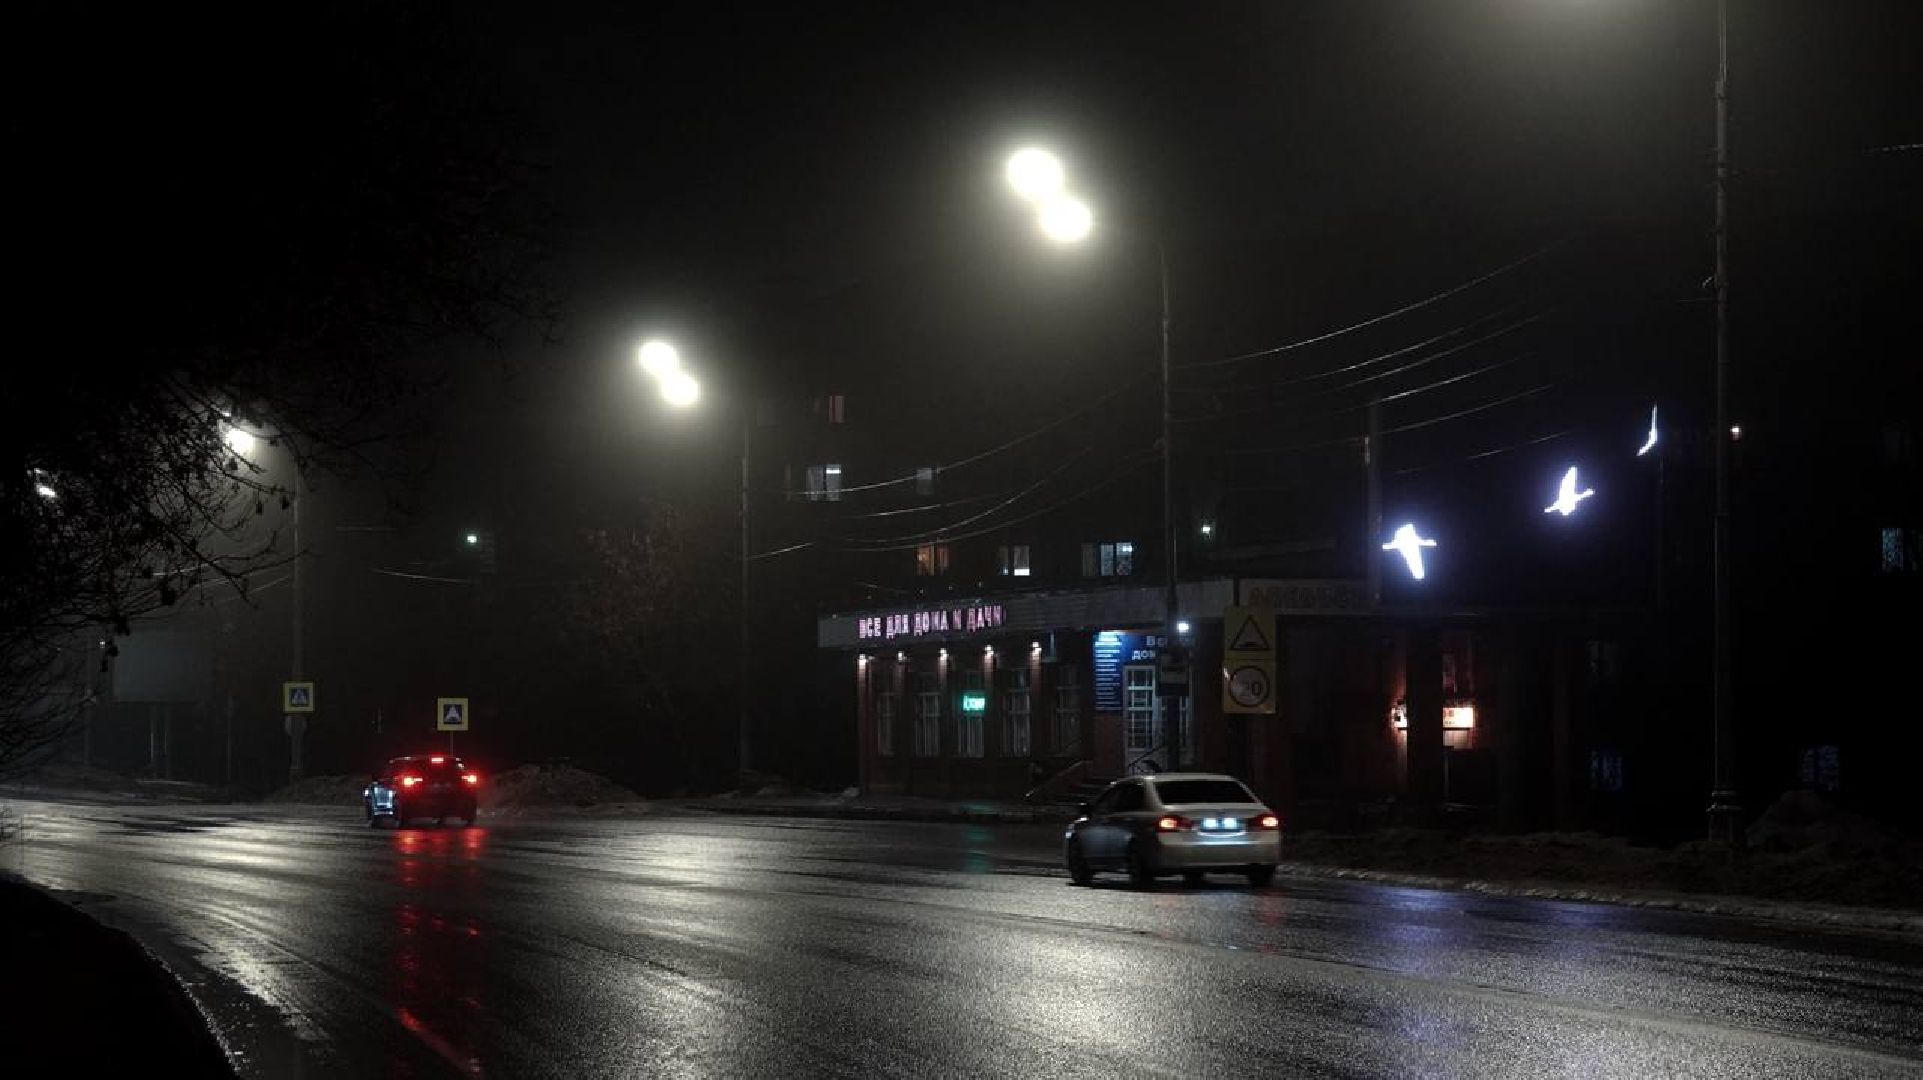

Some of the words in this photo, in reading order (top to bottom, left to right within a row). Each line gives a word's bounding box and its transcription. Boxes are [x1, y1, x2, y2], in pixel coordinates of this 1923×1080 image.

[859, 617, 881, 639] ВСЕ
[886, 614, 909, 639] ДЛЯ
[914, 610, 949, 637] ДОМА
[953, 608, 961, 630] И
